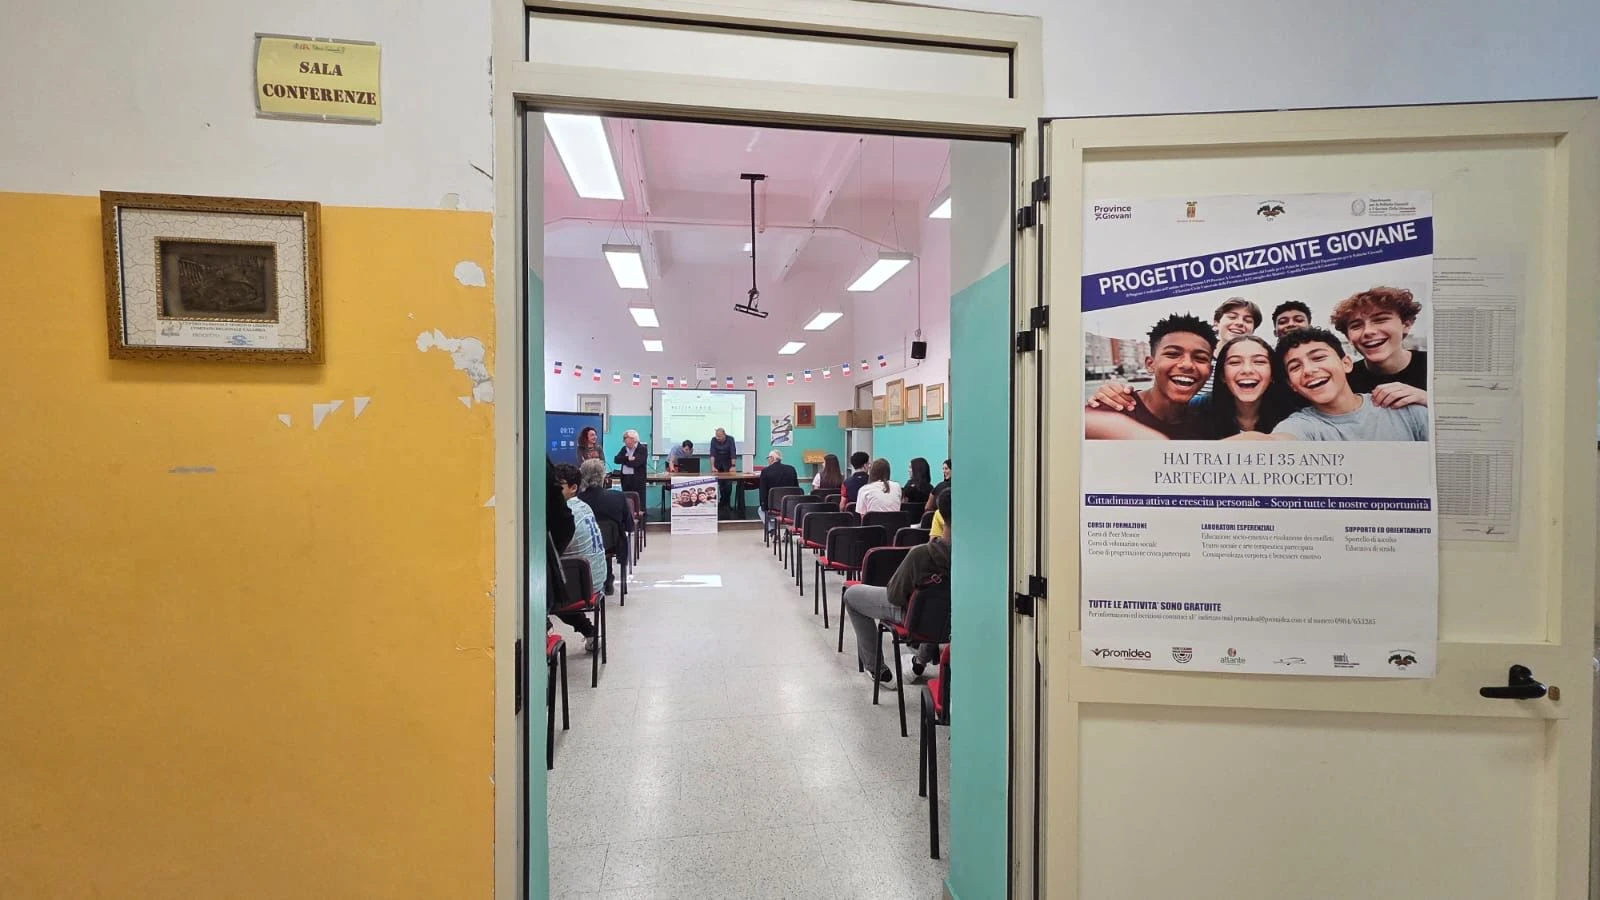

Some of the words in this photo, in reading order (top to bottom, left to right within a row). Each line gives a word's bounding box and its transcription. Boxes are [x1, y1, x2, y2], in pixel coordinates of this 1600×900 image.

[299, 61, 343, 76] SALA
[262, 83, 376, 106] CONFERENZE
[1098, 260, 1205, 295] PROGETTO
[1209, 239, 1323, 275] ORIZZONTE
[1326, 222, 1418, 254] GIOVANE
[1163, 452, 1189, 465] HAI
[1193, 452, 1222, 466] TRA
[1226, 453, 1231, 465] I
[1236, 454, 1252, 466] 14
[1256, 454, 1266, 466] E
[1277, 454, 1296, 466] 35
[1298, 454, 1345, 466] ANNI?
[1154, 472, 1237, 485] PARTECIPA
[1239, 472, 1260, 486] AL
[1263, 473, 1353, 486] PROGETTO!
[1087, 496, 1144, 506] Cittadinanza
[1145, 497, 1170, 506] attiva
[1179, 498, 1214, 506] crescita
[1216, 498, 1261, 508] personale
[1270, 498, 1302, 510] Scopri
[1303, 499, 1326, 508] tutte
[1328, 498, 1337, 508] le
[1338, 500, 1368, 509] nostre
[1370, 500, 1430, 510] opportunità
[1088, 600, 1112, 609] TUTTE
[1114, 600, 1122, 609] LE
[1160, 601, 1183, 611] SONO
[1184, 602, 1222, 612] GRATUITE
[1102, 648, 1152, 659] promidea
